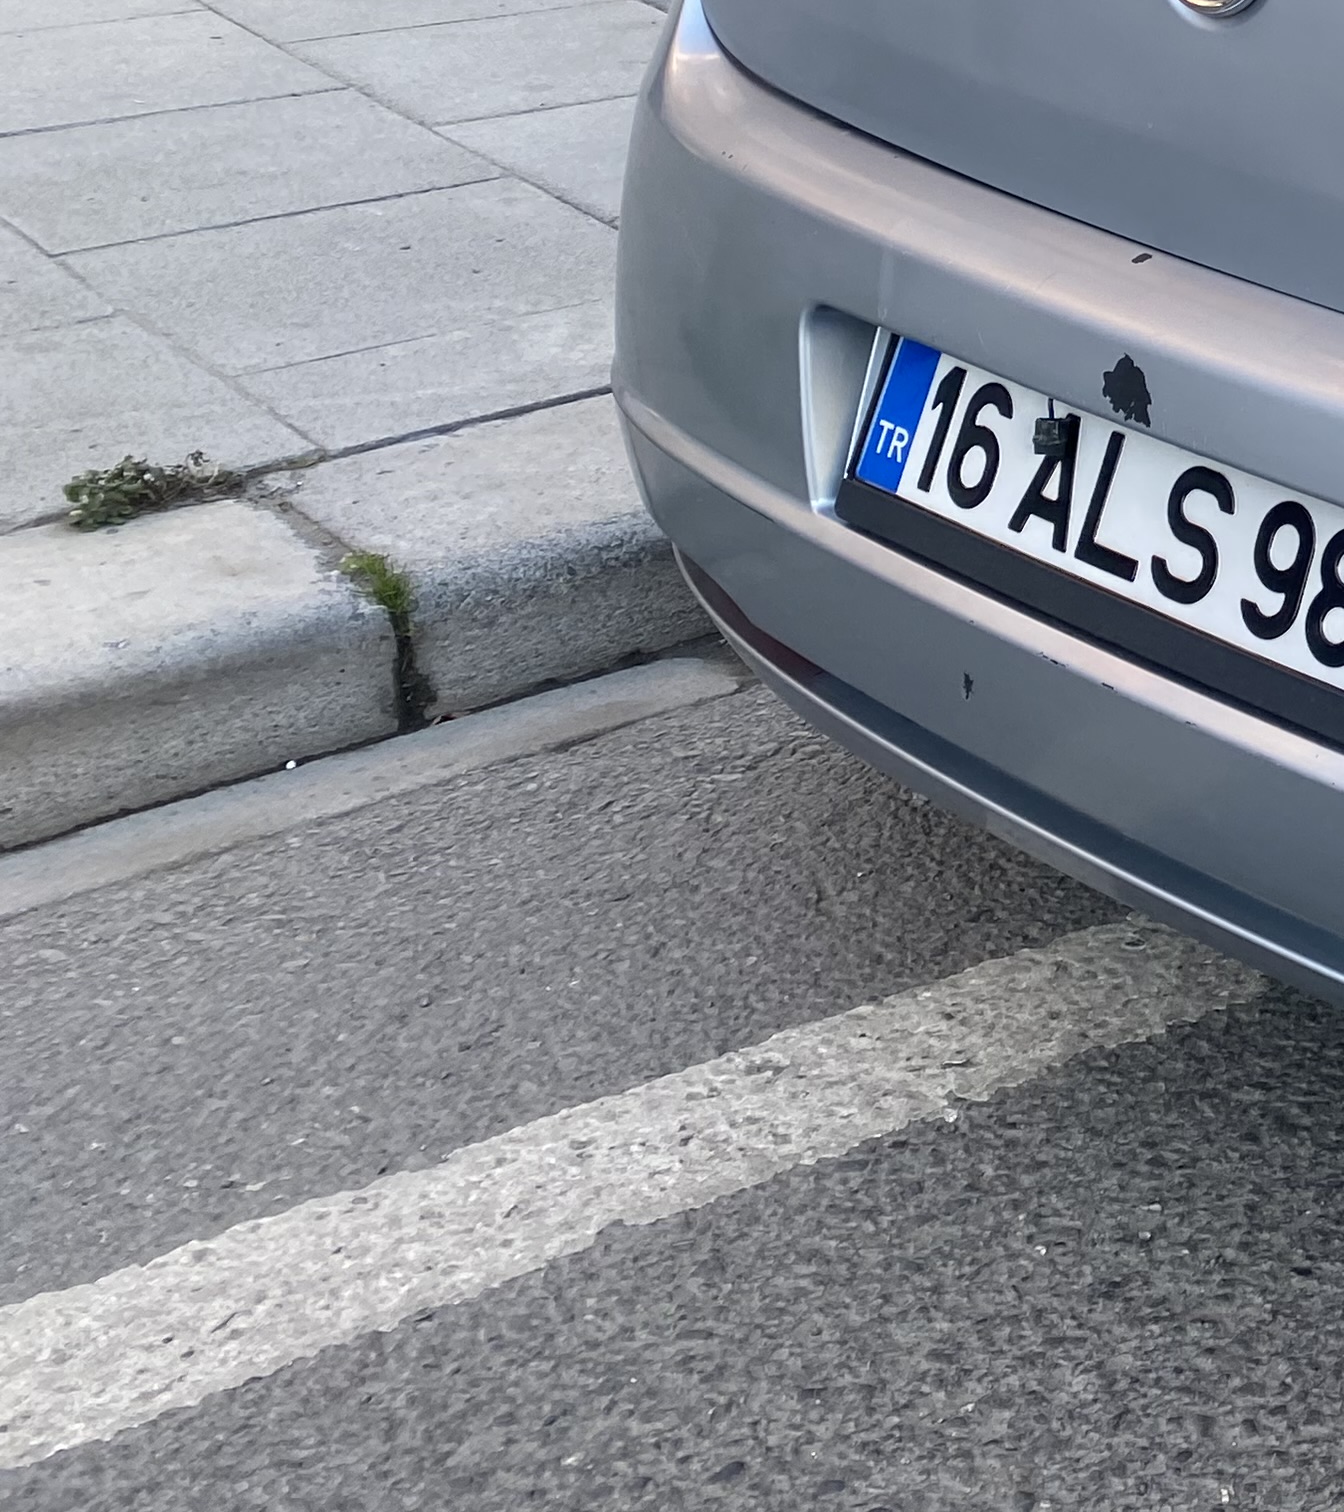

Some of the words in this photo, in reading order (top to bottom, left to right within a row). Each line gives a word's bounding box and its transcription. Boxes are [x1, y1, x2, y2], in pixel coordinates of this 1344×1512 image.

[876, 419, 909, 463] TR
[916, 366, 1014, 510] 16
[1008, 412, 1236, 605] ALS
